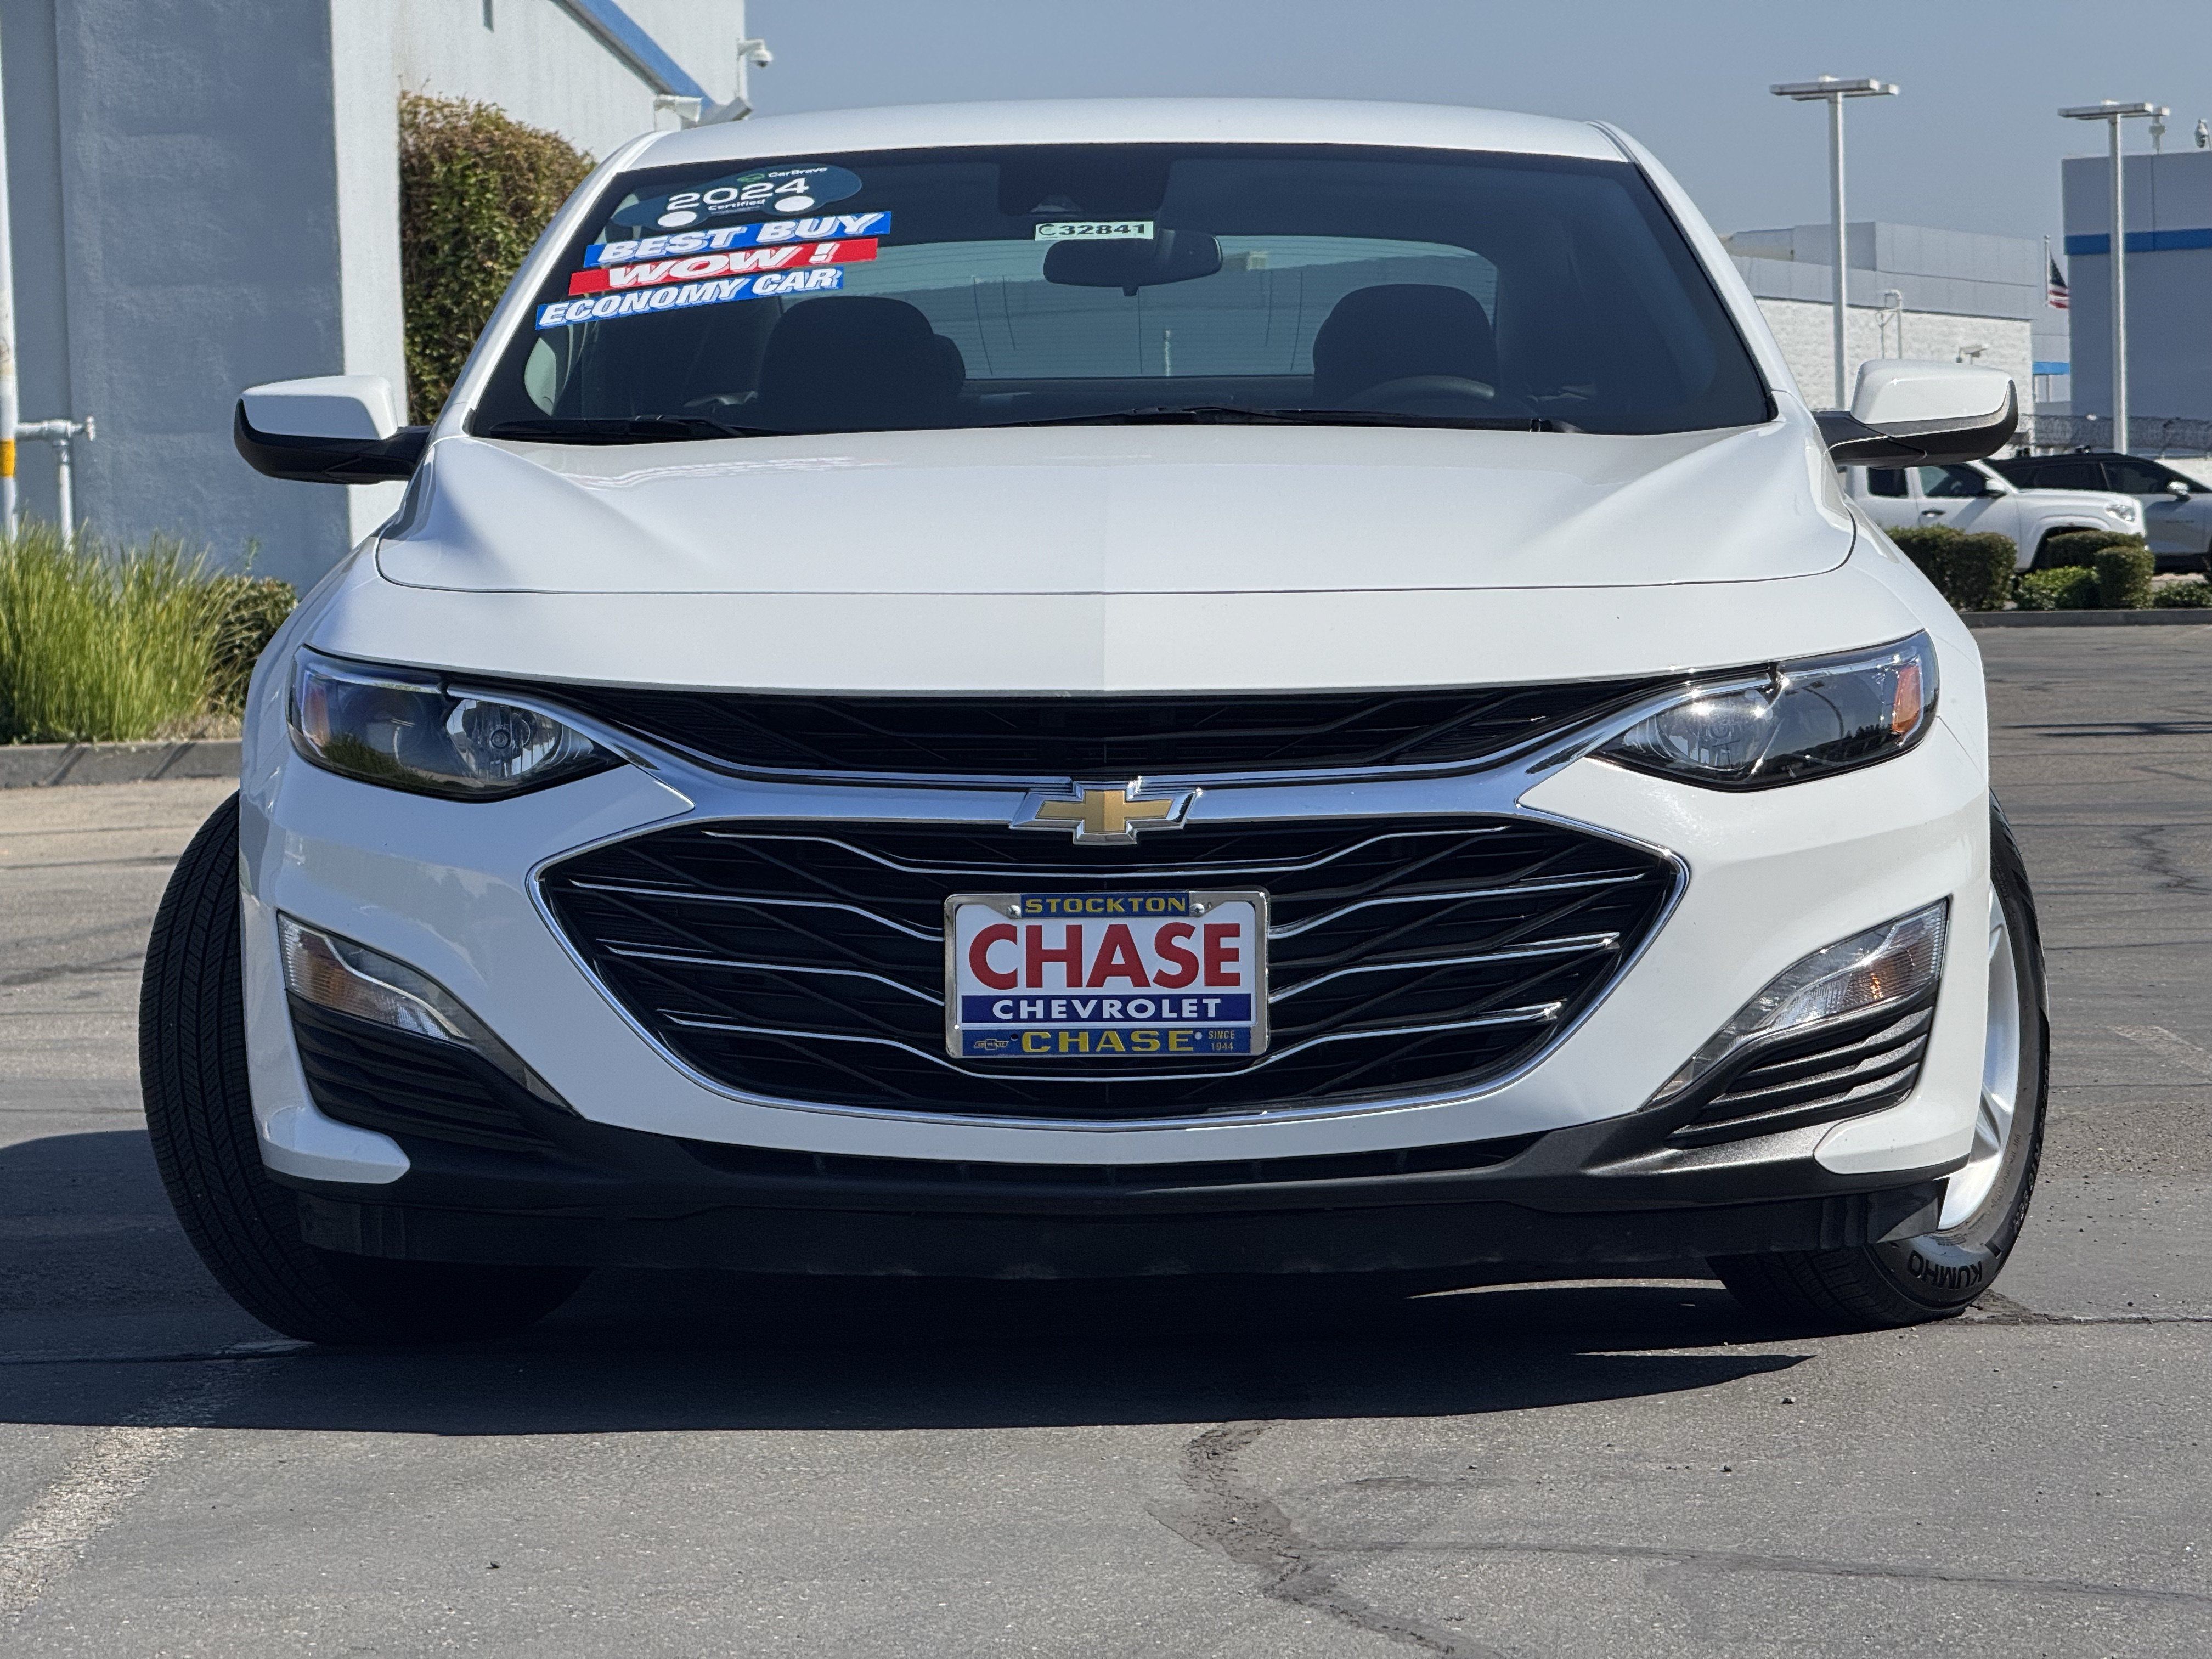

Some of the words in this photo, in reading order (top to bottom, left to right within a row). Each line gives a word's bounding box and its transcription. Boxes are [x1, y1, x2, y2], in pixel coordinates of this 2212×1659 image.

[667, 177, 809, 211] 2024
[708, 198, 765, 211] Certified
[598, 226, 748, 263] BEST
[755, 212, 885, 243] BUY
[609, 245, 803, 289] WOW
[539, 277, 752, 327] ECONOMY
[752, 268, 842, 296] CAR
[1025, 897, 1186, 913] STOCKTON
[969, 922, 1241, 990] CHASE
[992, 998, 1221, 1020] CHEVROLET
[1022, 1030, 1194, 1053] CHASE
[1208, 1030, 1235, 1040] SINCE
[1211, 1042, 1234, 1051] 1944
[1906, 1249, 1983, 1290] KUMHO
